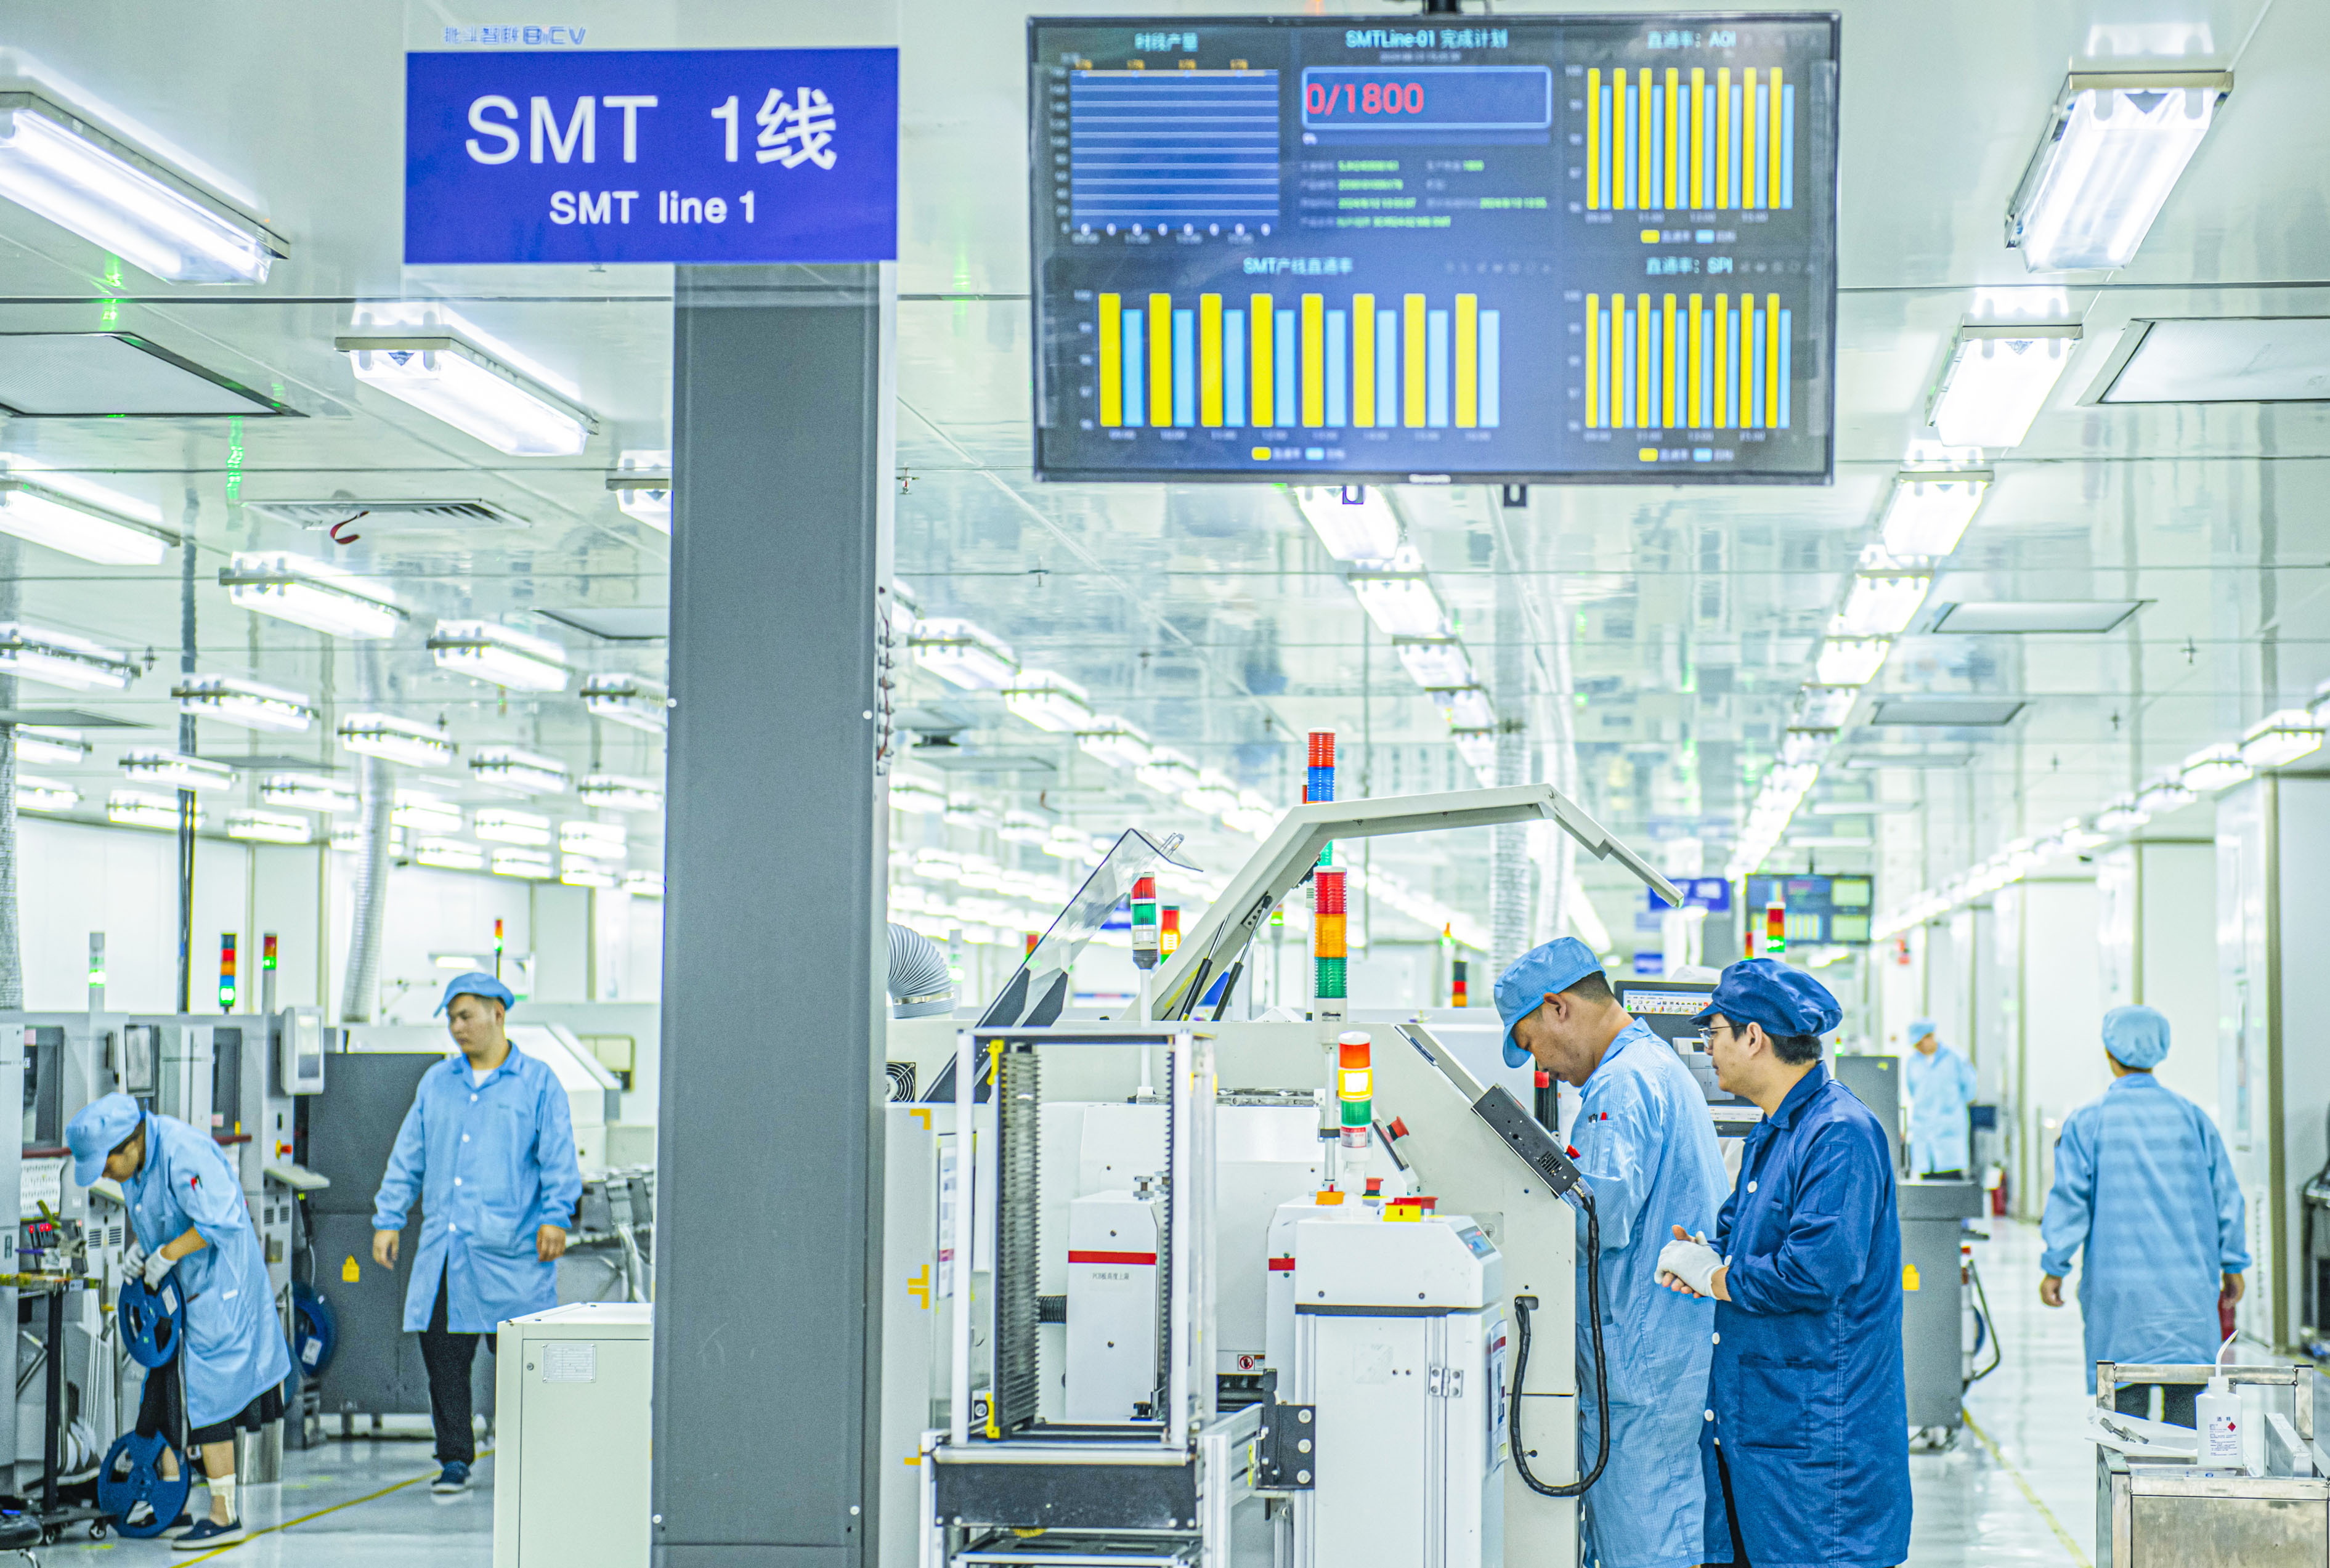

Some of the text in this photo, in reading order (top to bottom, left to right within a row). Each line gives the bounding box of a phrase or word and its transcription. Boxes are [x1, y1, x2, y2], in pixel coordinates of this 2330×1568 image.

[1306, 83, 1424, 116] 0/1800
[465, 87, 838, 170] SMT 1线
[549, 190, 755, 225] SMT line 1
[1707, 257, 1733, 274] SPI
